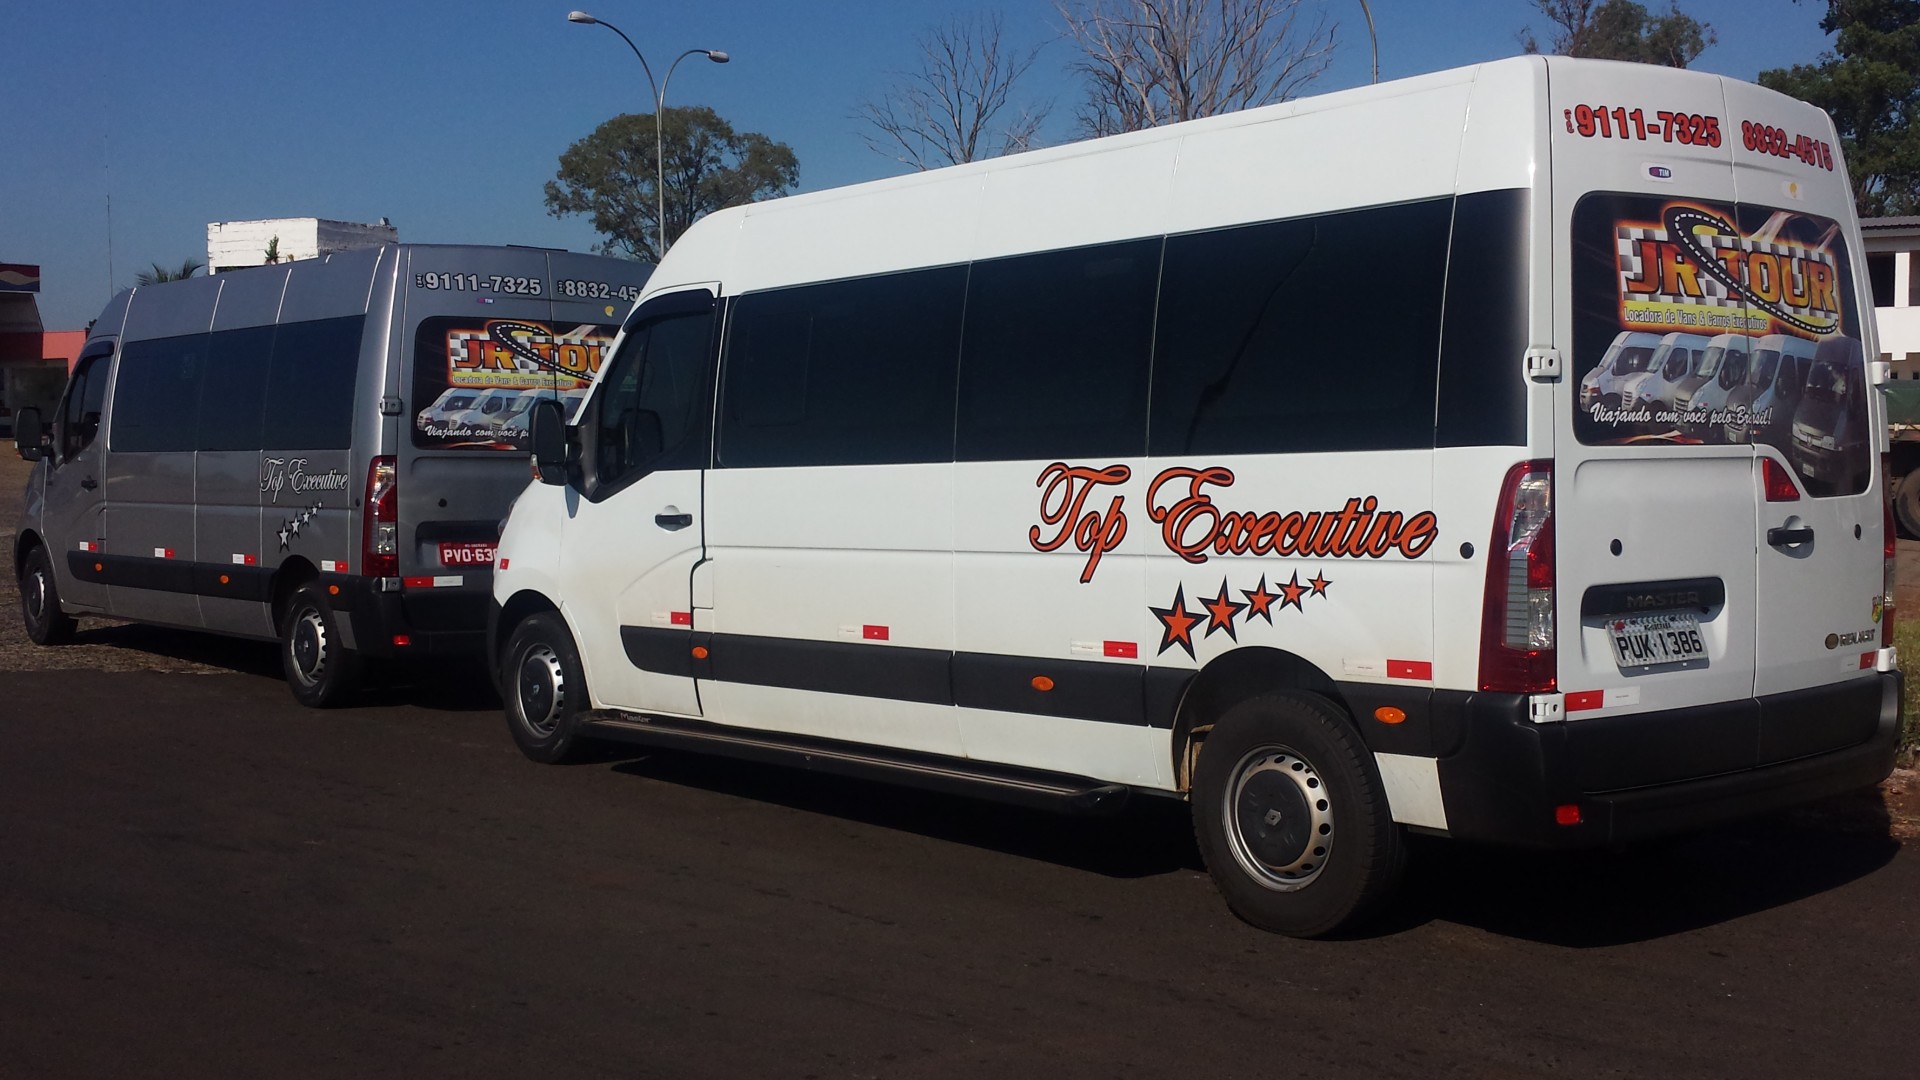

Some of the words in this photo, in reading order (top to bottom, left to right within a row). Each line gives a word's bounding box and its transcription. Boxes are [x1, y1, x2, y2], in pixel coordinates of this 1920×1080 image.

[1574, 104, 1721, 148] 9111-7325
[1741, 120, 1833, 172] 8832-4515
[426, 272, 542, 295] 9111-7325
[1625, 239, 1705, 298] JR
[1716, 246, 1838, 312] TOUR
[565, 280, 642, 302] 8832-45
[1624, 306, 1662, 323] Locadora
[1664, 309, 1675, 324] de
[1677, 310, 1696, 325] Vans
[1700, 311, 1705, 326] &
[1707, 312, 1730, 328] Carros
[1732, 313, 1768, 330] Executivos
[455, 339, 518, 370] JR
[1590, 402, 1651, 427] Viajando
[1655, 410, 1679, 424] com
[1683, 407, 1706, 424] você
[1708, 407, 1732, 429] pelo
[425, 425, 472, 438] Viajando
[475, 429, 494, 437] com
[498, 427, 517, 437] você
[260, 457, 285, 504] Top
[287, 458, 349, 494] Executive
[1029, 462, 1131, 584] Top
[1146, 466, 1438, 564] Executive
[1626, 591, 1699, 608] MASTER
